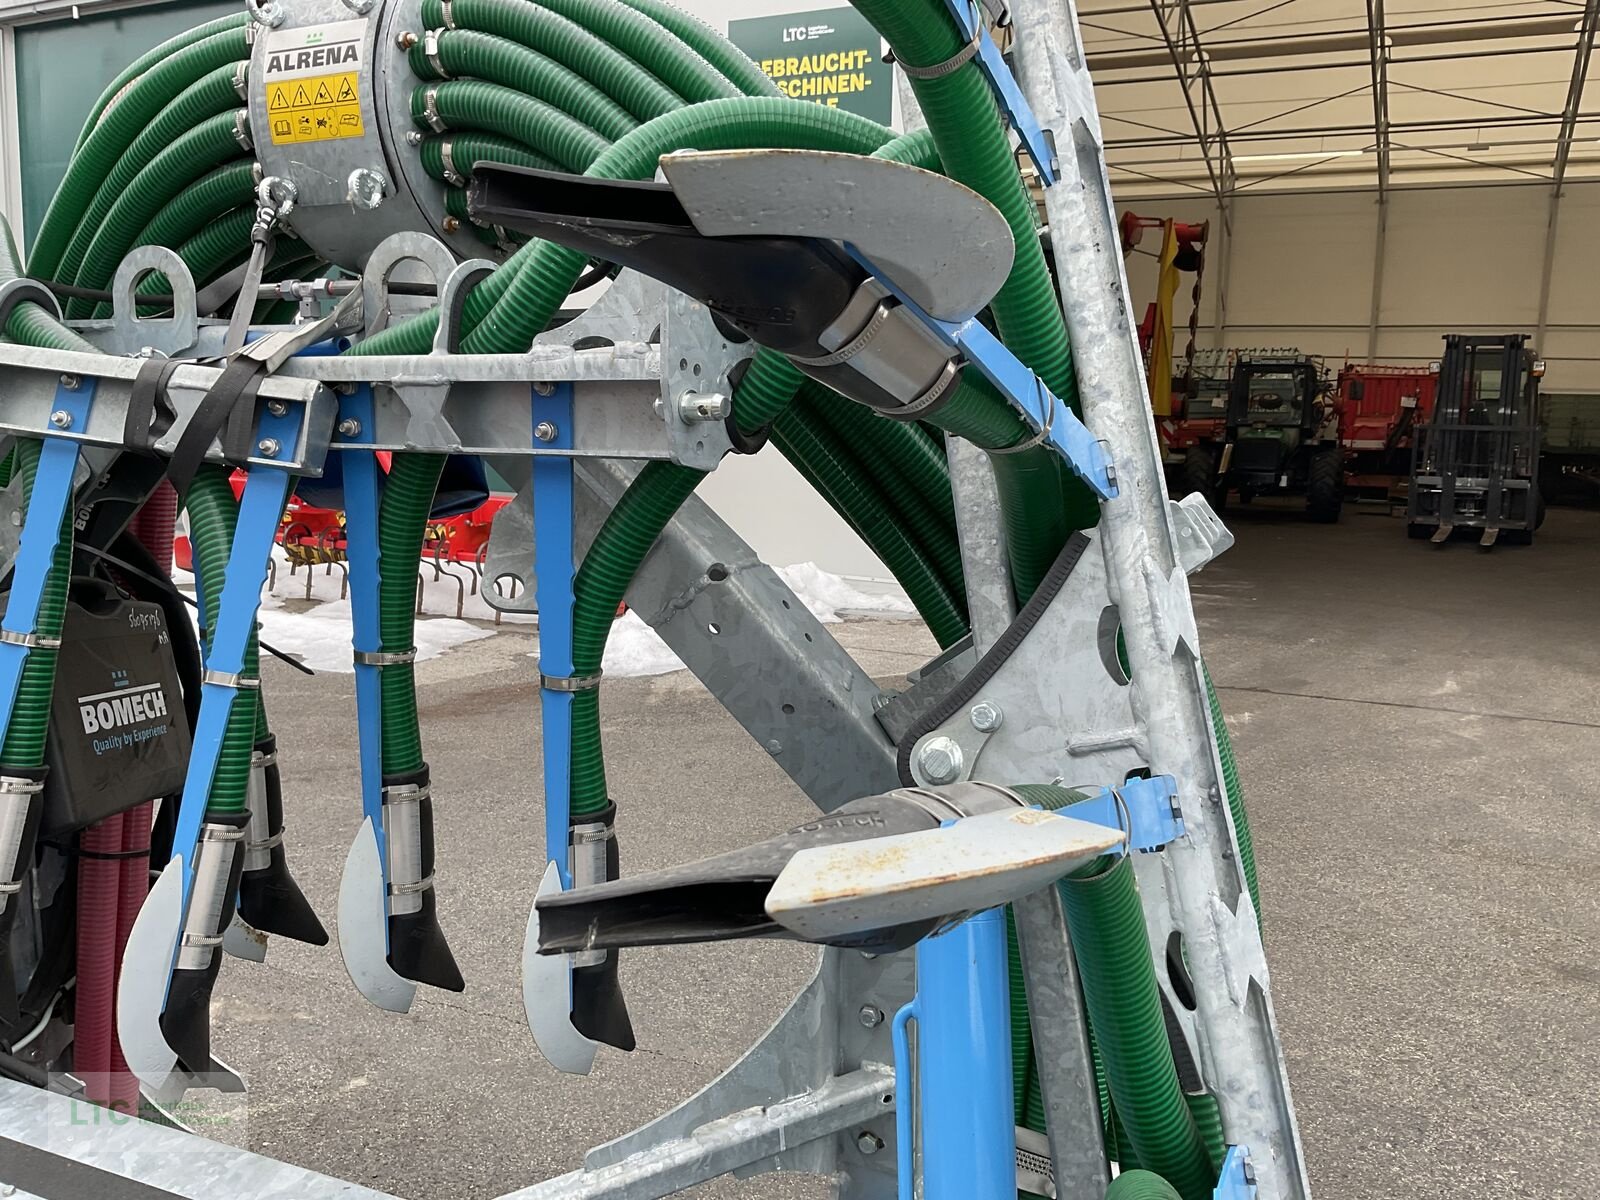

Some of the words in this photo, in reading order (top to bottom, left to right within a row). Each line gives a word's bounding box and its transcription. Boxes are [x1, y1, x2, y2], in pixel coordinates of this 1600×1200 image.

[783, 26, 807, 43] LTC
[266, 44, 359, 74] ALRENA
[756, 50, 872, 78] EBRAUCHT-
[80, 690, 168, 735] BOMECH
[93, 735, 122, 756] Quality
[123, 731, 134, 747] by
[134, 724, 168, 743] Experience
